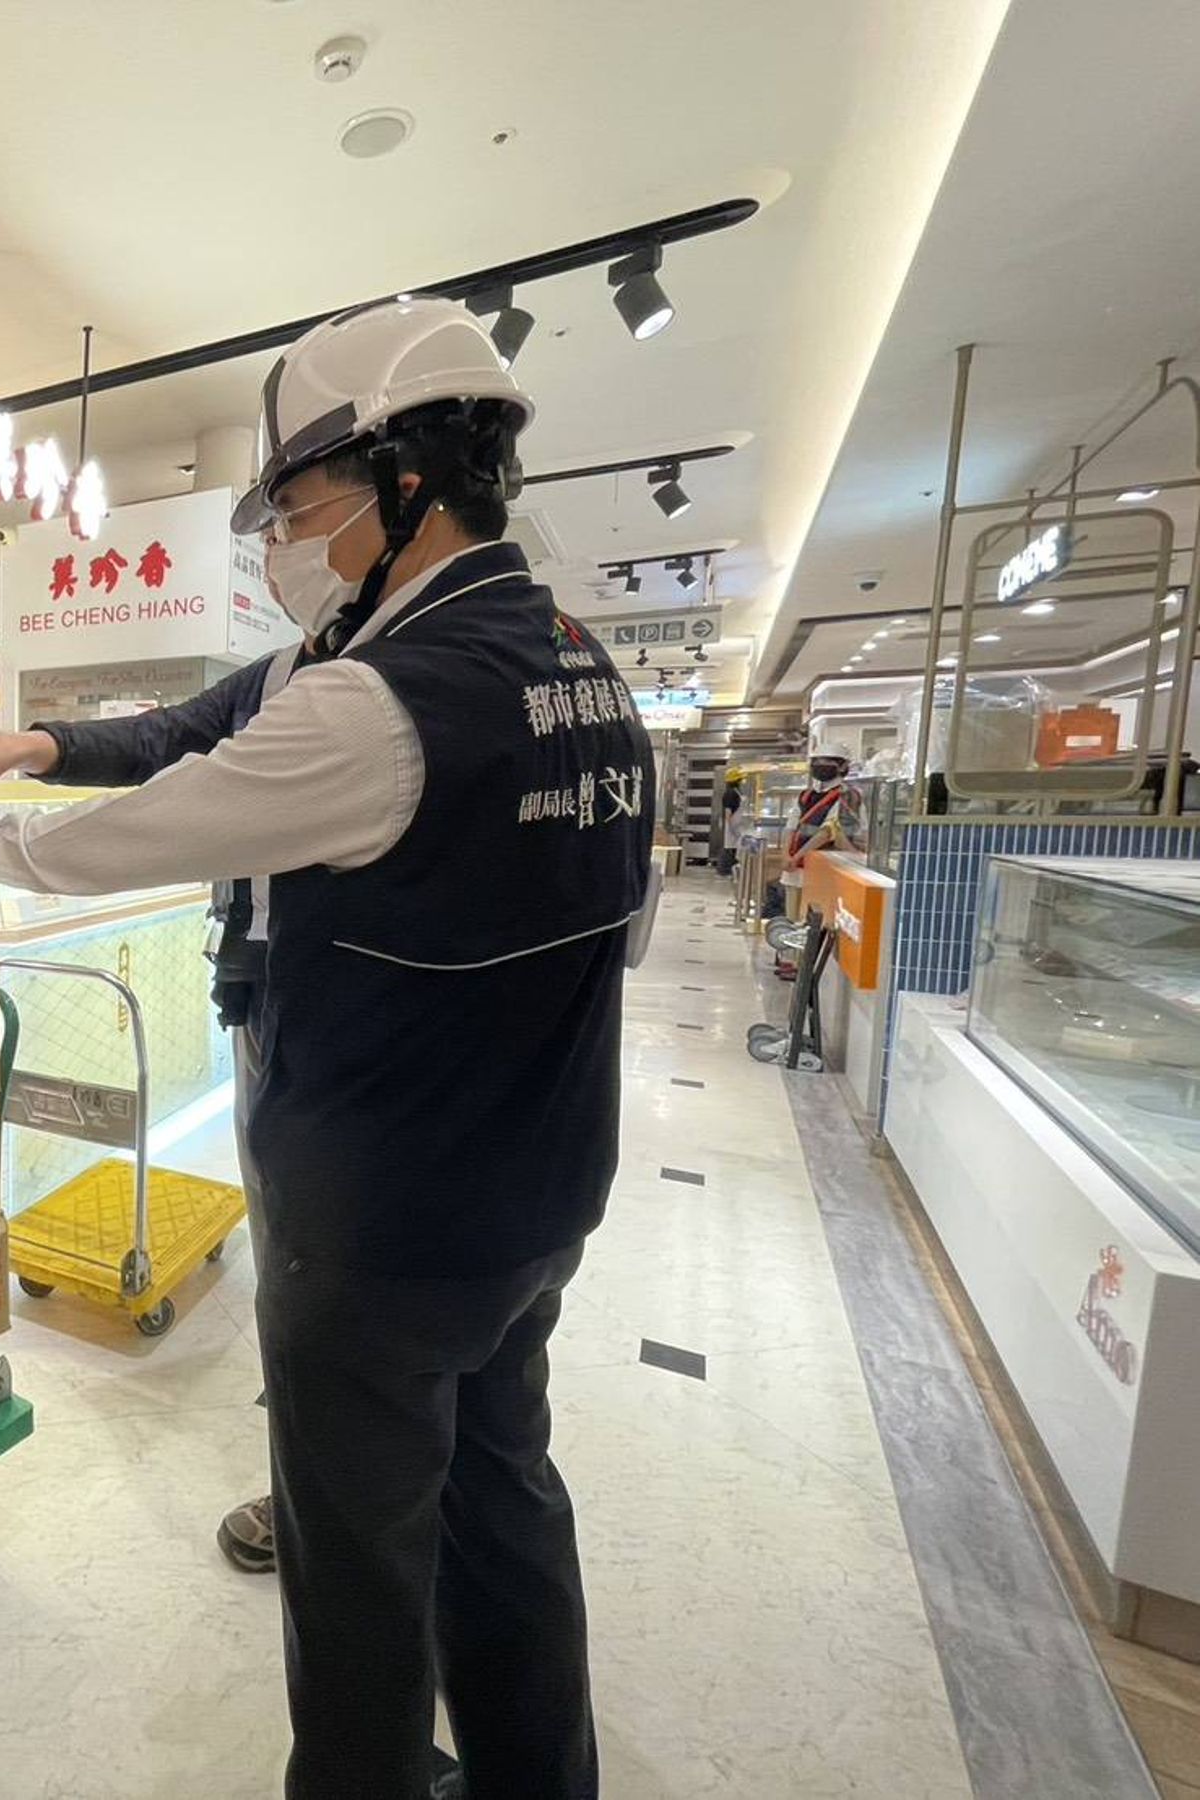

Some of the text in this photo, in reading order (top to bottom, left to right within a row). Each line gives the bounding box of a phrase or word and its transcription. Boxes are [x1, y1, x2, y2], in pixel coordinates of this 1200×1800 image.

[49, 540, 173, 601] 美珍香
[19, 612, 55, 632] BEE
[61, 603, 131, 628] CHENG
[138, 595, 205, 620] HIANG
